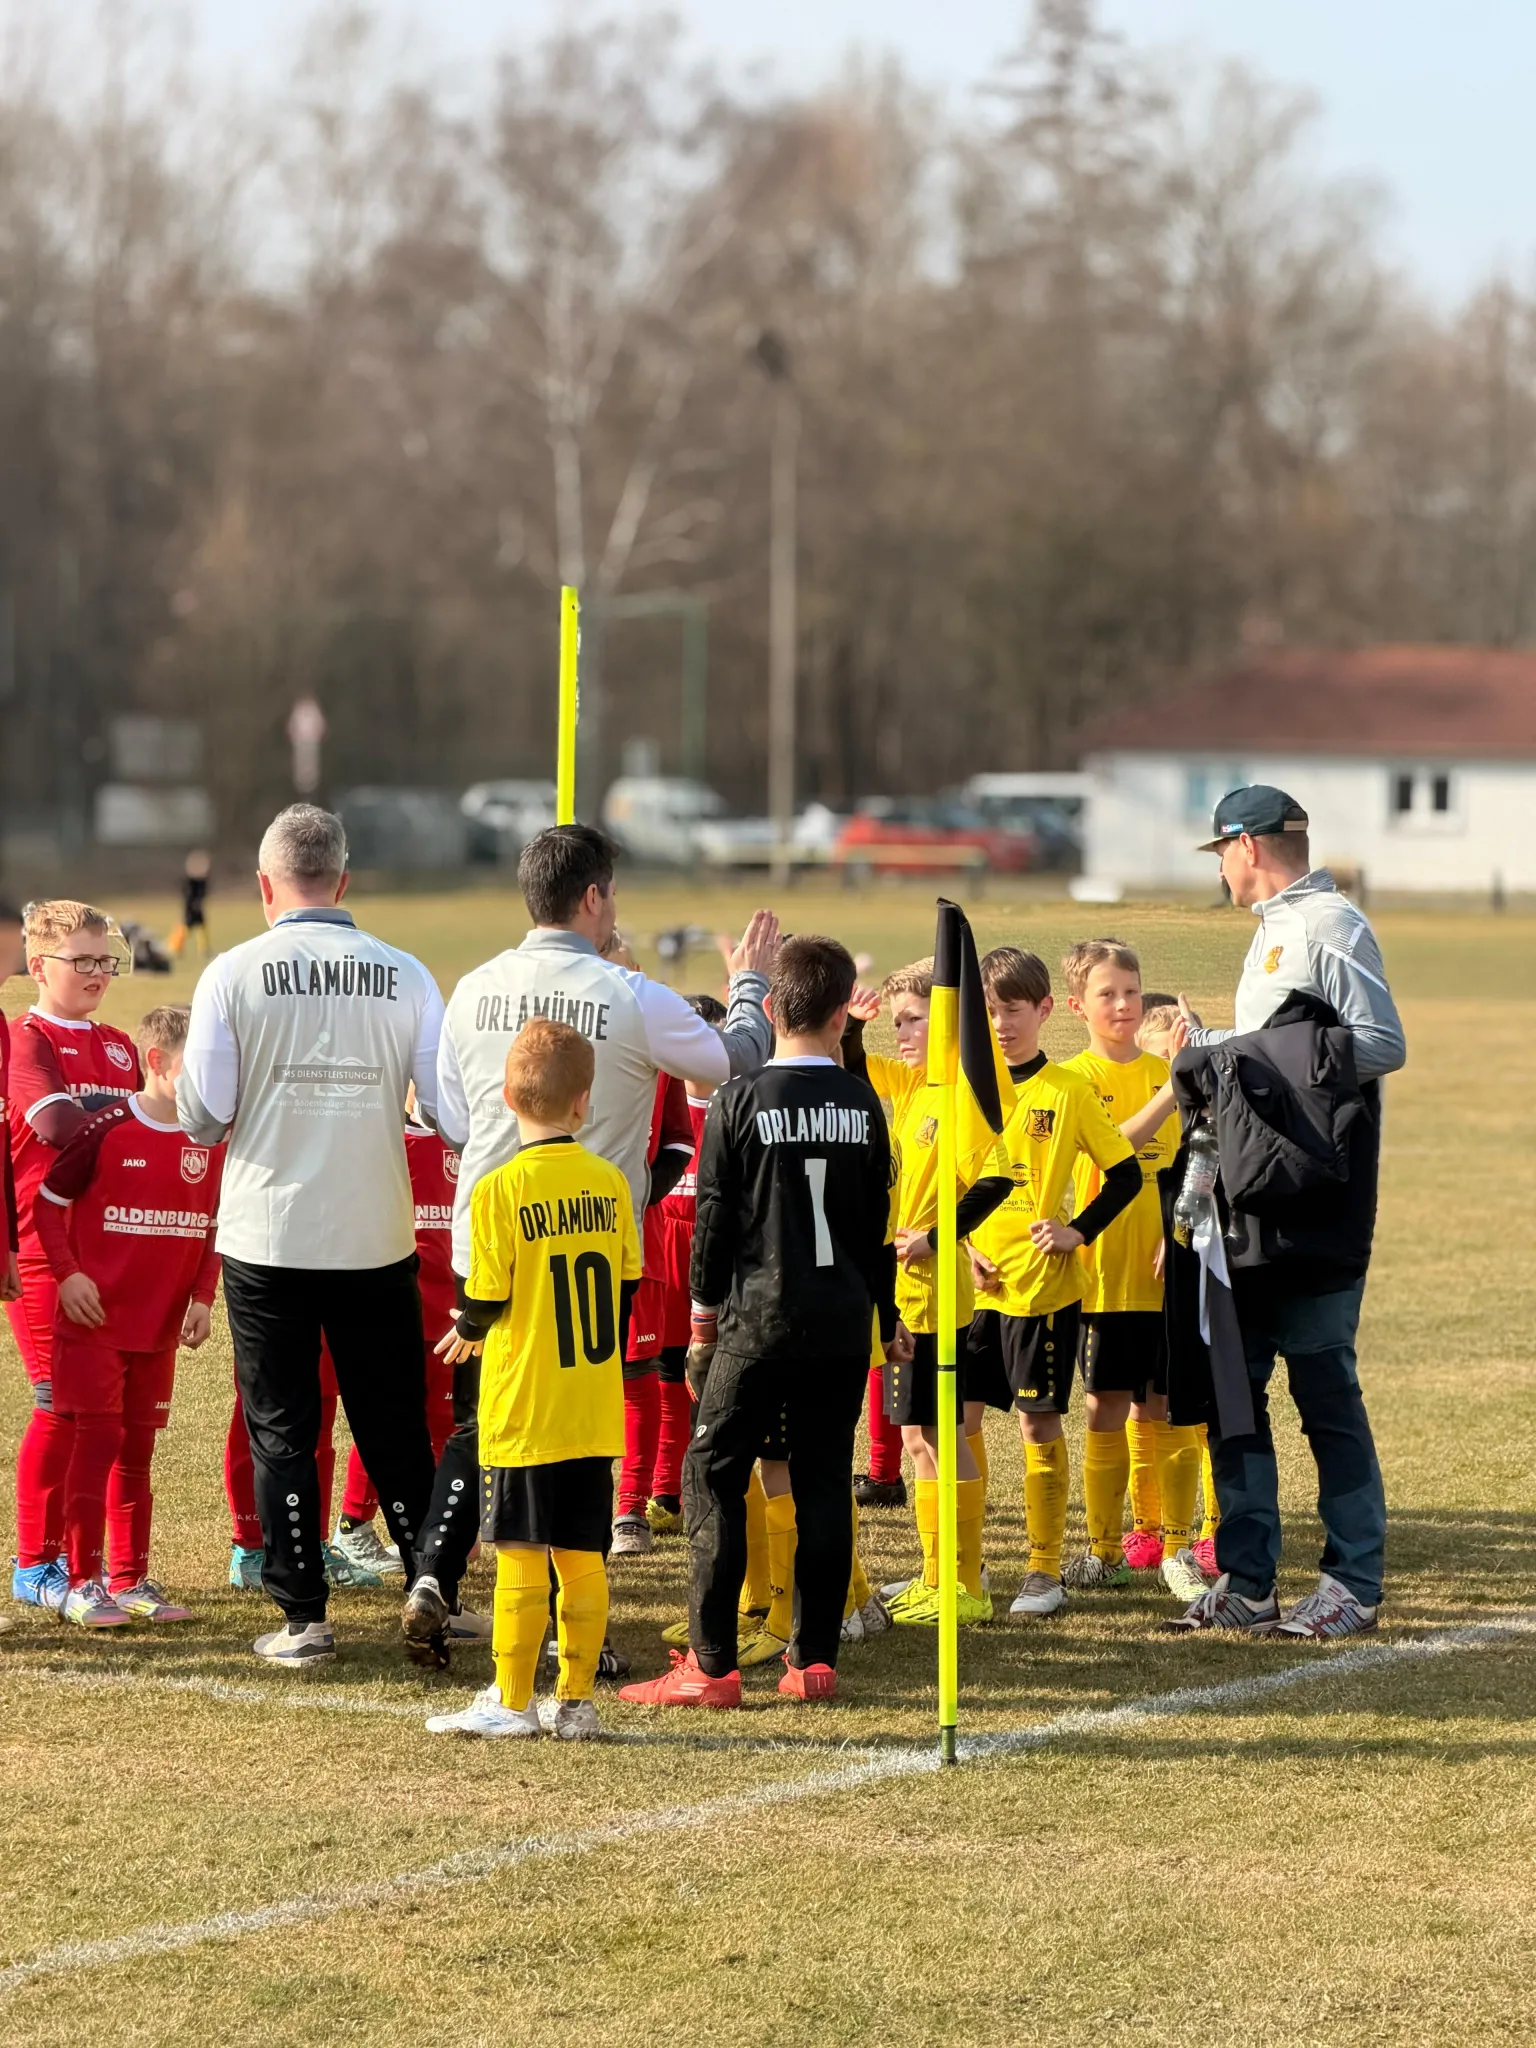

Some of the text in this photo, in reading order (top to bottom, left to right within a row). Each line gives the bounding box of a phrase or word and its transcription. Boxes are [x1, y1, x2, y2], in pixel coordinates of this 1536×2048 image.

[262, 954, 399, 1002] ORLAMÜNDE
[475, 990, 611, 1041] ORLAMÜNDE
[297, 1069, 378, 1080] DIENSTLEISTUNGEN
[756, 1101, 870, 1147] ORLAMÜNDE
[122, 1158, 147, 1168] JAKO
[104, 1205, 210, 1228] OLDENBURG
[519, 1189, 617, 1242] ORLAMÜNDE
[804, 1157, 836, 1267] 1
[549, 1250, 617, 1369] 10
[636, 1333, 656, 1344] JAKO
[1017, 1388, 1038, 1398] JAKO
